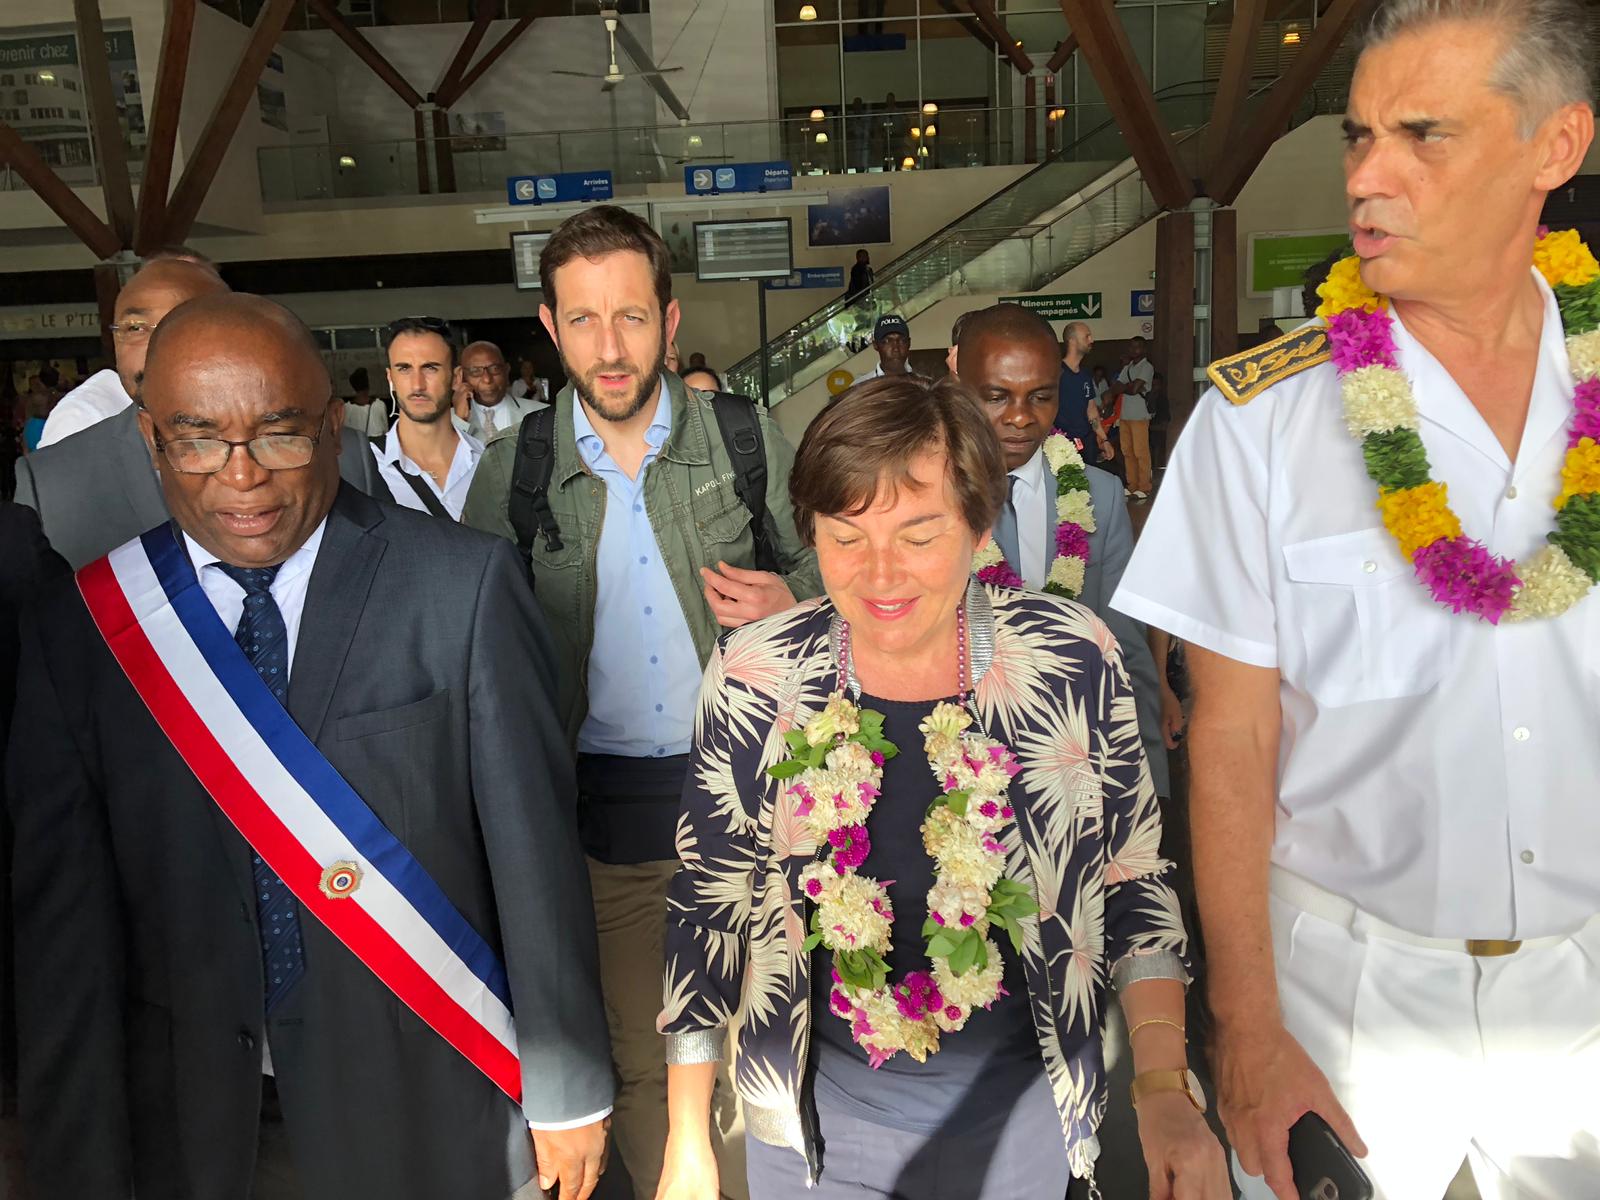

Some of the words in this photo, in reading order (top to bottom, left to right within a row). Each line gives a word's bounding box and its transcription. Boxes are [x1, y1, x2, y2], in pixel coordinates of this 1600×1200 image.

[40, 43, 68, 58] chez
[583, 178, 609, 186] Arrivées
[41, 313, 56, 328] LE
